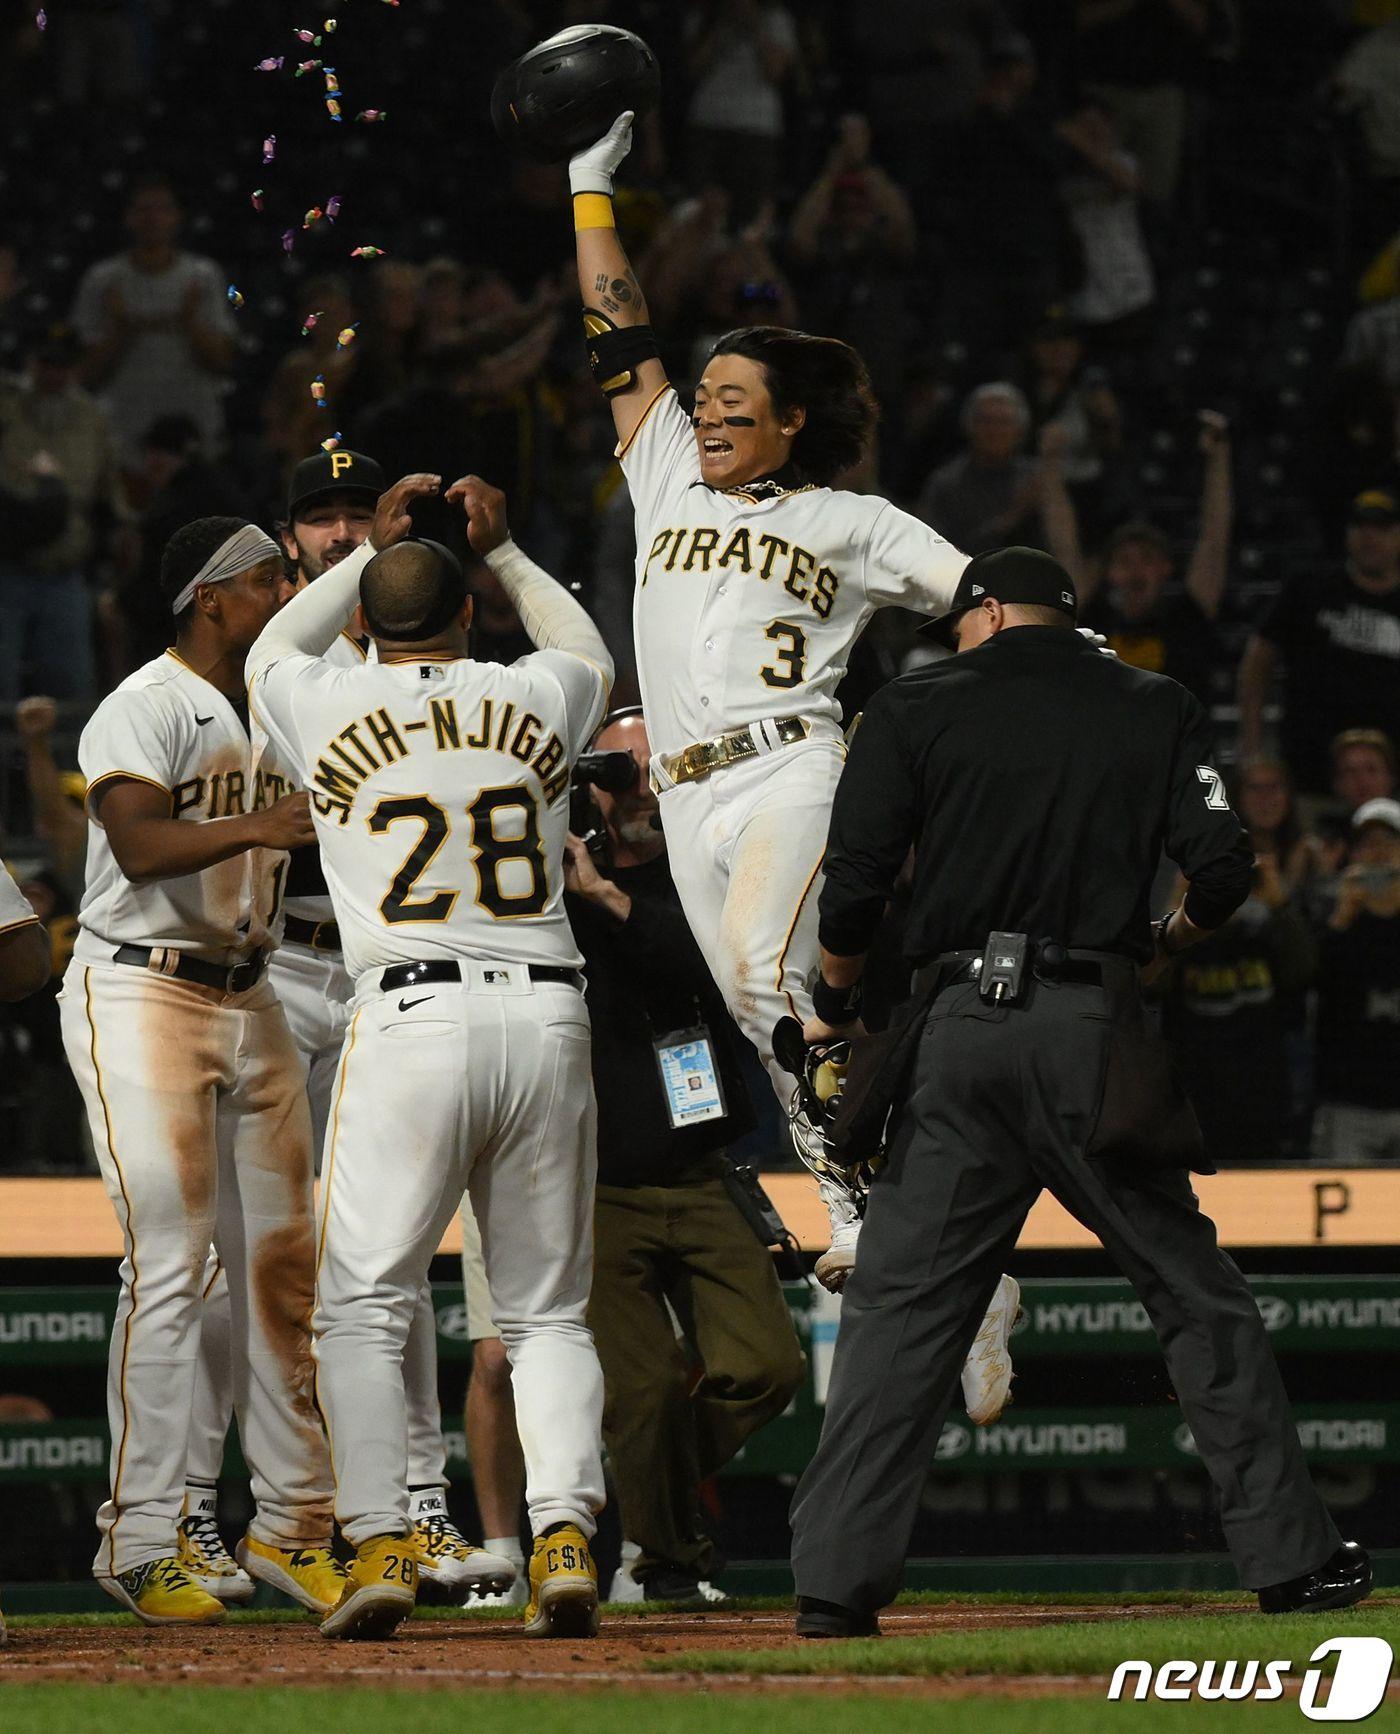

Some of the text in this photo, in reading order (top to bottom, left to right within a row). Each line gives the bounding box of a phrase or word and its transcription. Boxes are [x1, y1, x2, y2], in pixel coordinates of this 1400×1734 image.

[331, 453, 353, 478] P
[641, 526, 840, 619] PIRATES
[759, 619, 809, 690] 3
[310, 699, 569, 825] SMITH-NJIGBA
[171, 770, 296, 819] PIRAT
[1195, 765, 1230, 810] 7
[365, 783, 550, 927] 28
[1312, 1181, 1351, 1238] P
[1297, 1298, 1400, 1328] HYUN
[974, 1424, 1127, 1455] HYUNDAI
[382, 1555, 413, 1585] 28
